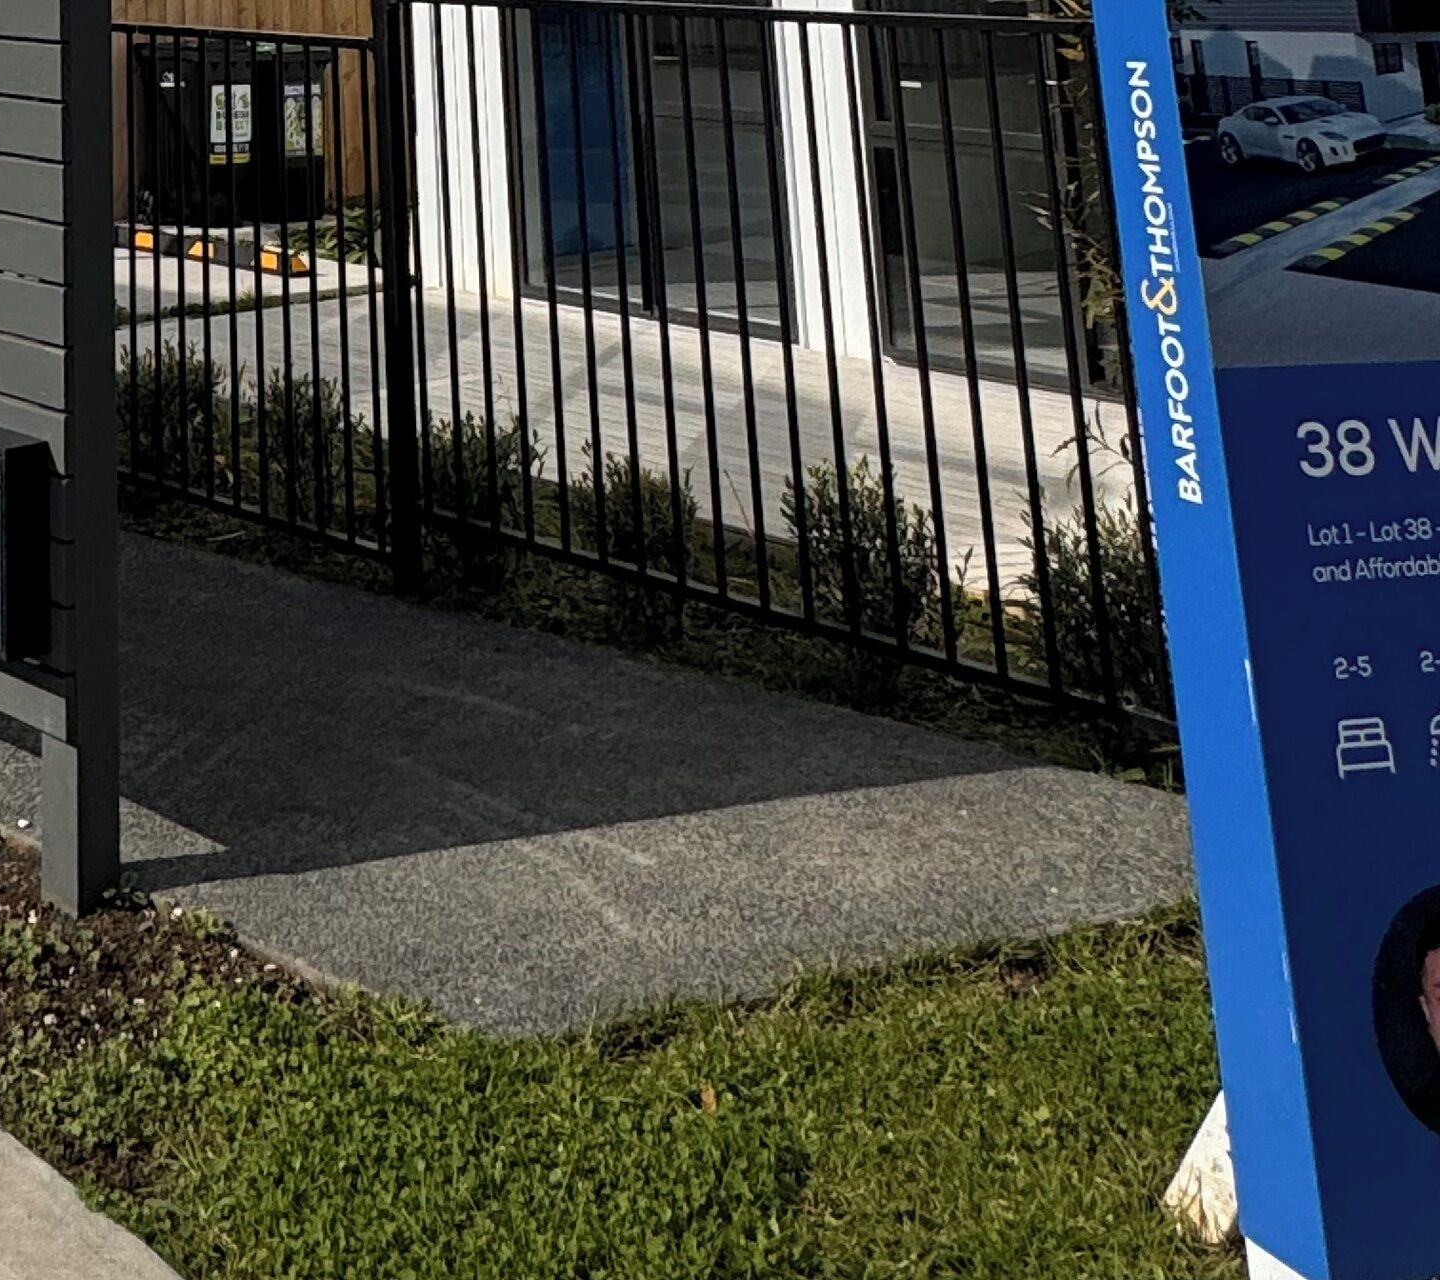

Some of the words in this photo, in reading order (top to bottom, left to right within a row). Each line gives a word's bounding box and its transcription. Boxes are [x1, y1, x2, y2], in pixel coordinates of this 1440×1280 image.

[1296, 419, 1375, 478] 38
[1307, 523, 1340, 546] Lot
[1369, 520, 1403, 542] Lot
[1403, 517, 1433, 540] 38
[1312, 558, 1352, 582] and
[1355, 552, 1440, 579] Affordab
[1333, 655, 1372, 679] 2-5
